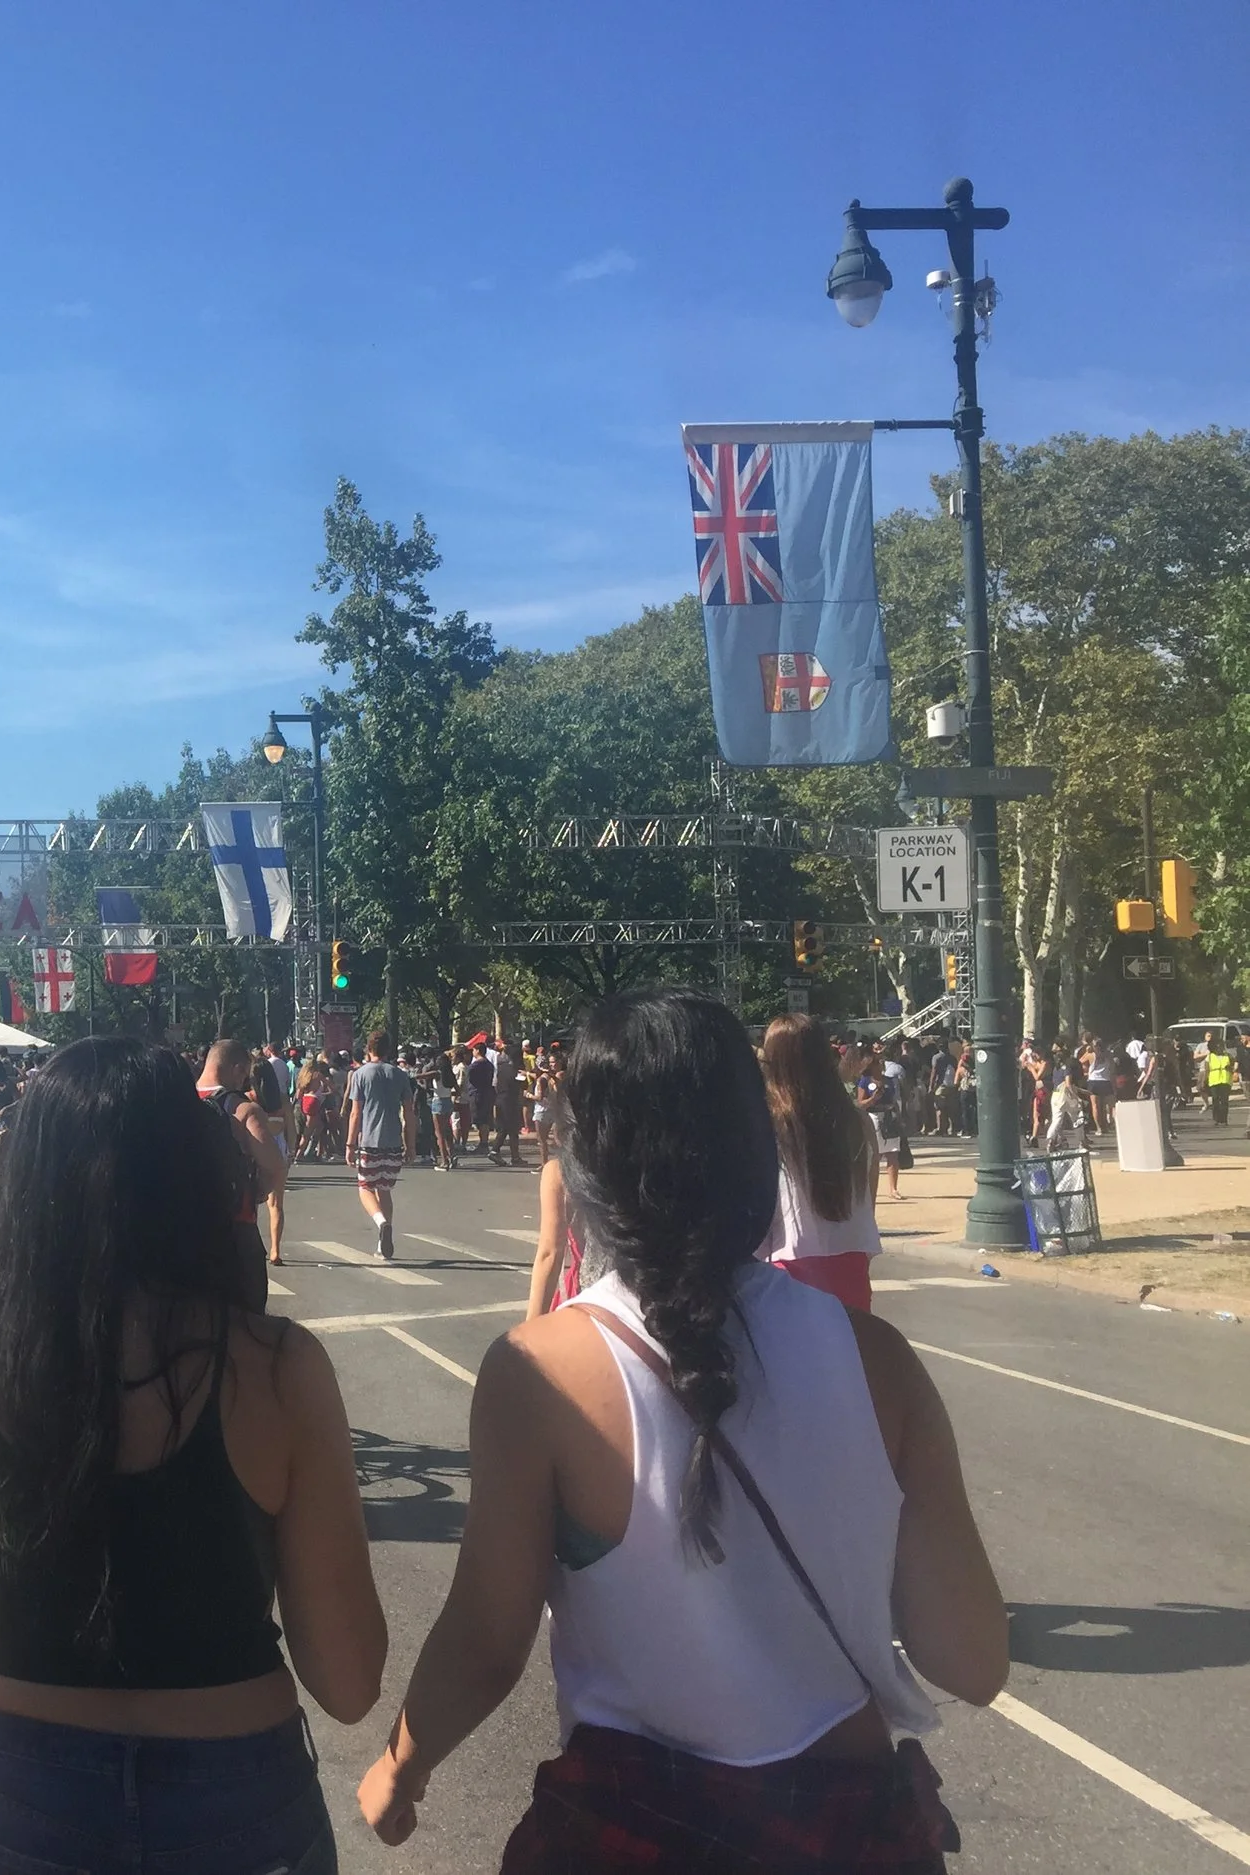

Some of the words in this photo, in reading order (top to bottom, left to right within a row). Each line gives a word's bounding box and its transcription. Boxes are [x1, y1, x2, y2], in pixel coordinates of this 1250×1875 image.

[891, 835, 953, 846] PARKWAY
[889, 847, 956, 858] LOCATION
[901, 865, 945, 903] K-1
